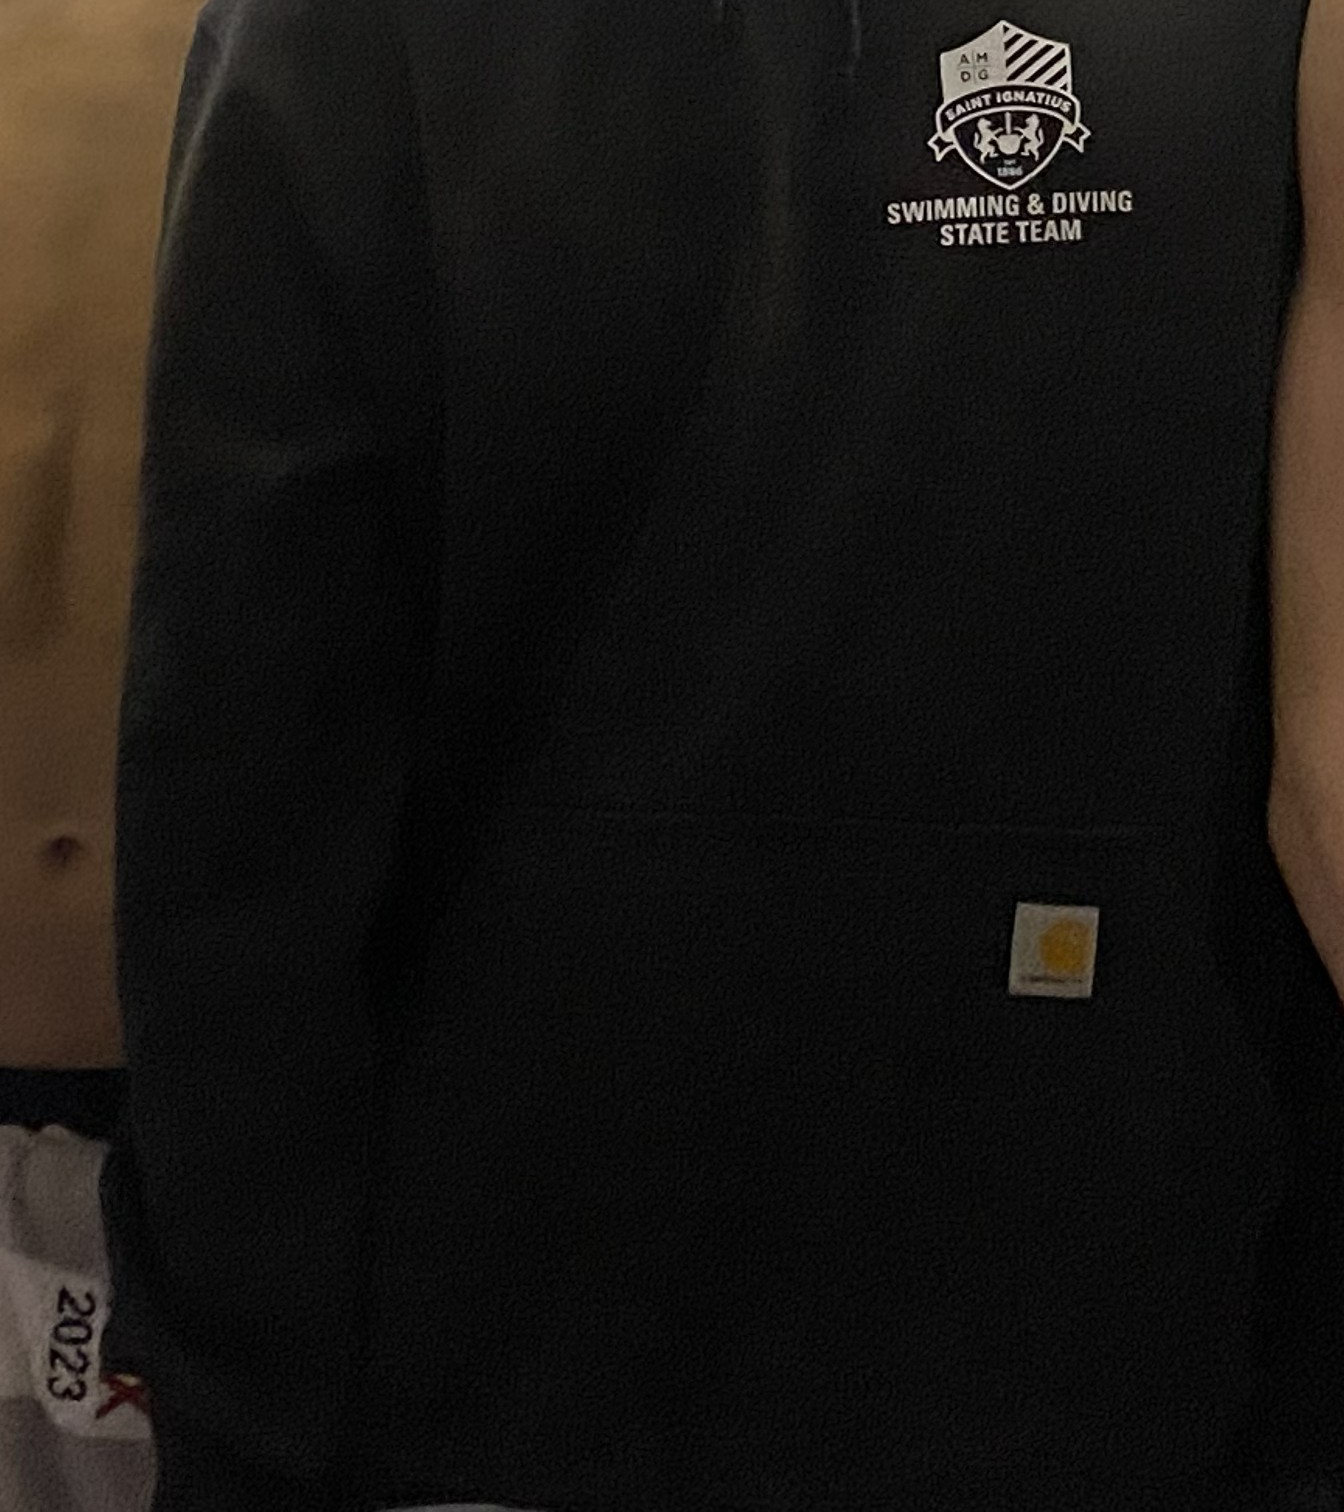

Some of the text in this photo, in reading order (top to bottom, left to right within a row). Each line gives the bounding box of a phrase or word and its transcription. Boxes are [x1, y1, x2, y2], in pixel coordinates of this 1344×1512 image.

[944, 89, 1073, 122] SAINT IGNATIUS
[886, 190, 1133, 225] SWIMMING & DIVING
[939, 218, 1083, 247] STATE TEAM
[47, 1285, 96, 1402] 2023
